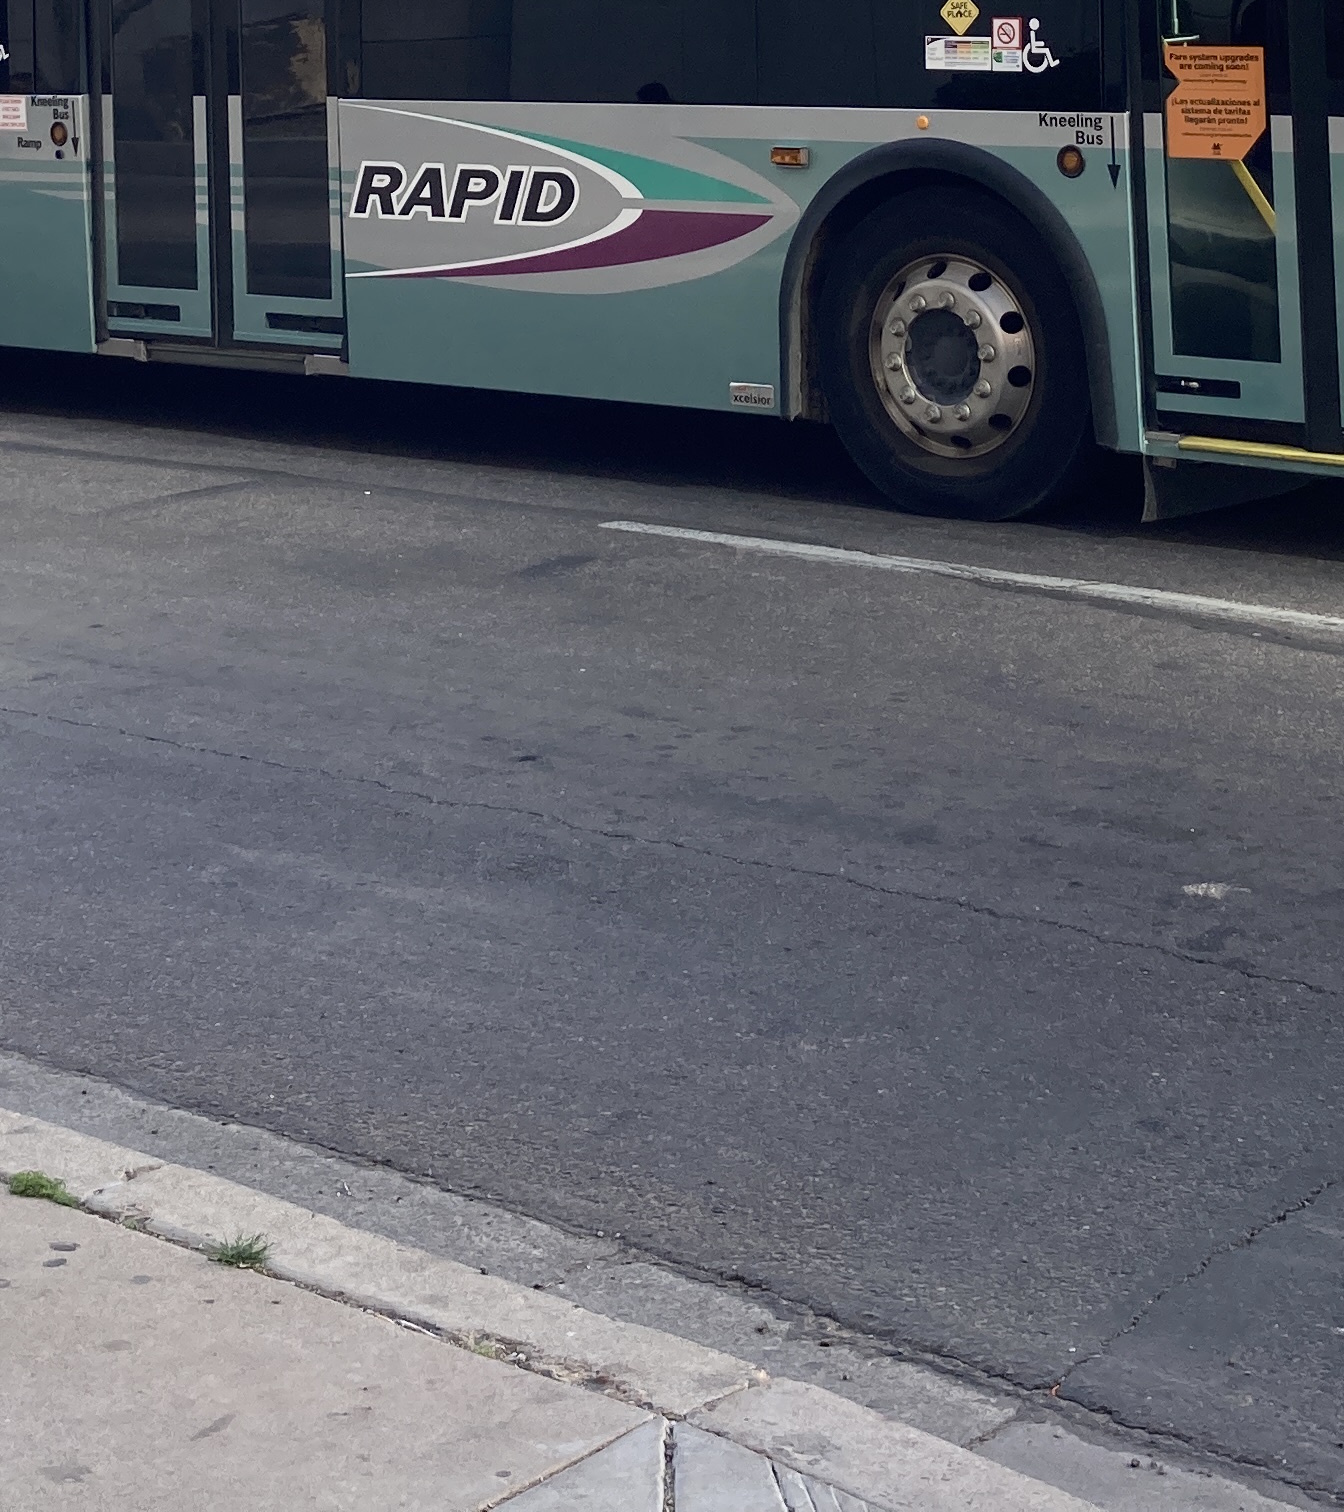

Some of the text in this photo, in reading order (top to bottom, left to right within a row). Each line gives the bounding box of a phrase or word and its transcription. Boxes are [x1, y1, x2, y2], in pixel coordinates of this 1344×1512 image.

[950, 1, 968, 10] SAFE
[1169, 52, 1259, 63] Fare system upgrades
[1194, 62, 1224, 72] coming
[1225, 63, 1250, 71] soon!
[31, 95, 69, 109] Kneeling
[1189, 97, 1251, 107] actualizaciones
[1252, 98, 1261, 107] al
[53, 108, 69, 120] Bus
[1181, 107, 1251, 116] sistema de tarifas
[1038, 112, 1103, 131] Kneeling
[1217, 117, 1248, 126] pronto!
[1075, 130, 1104, 145] Bus
[17, 136, 42, 151] Ramp
[351, 162, 578, 225] RAPID
